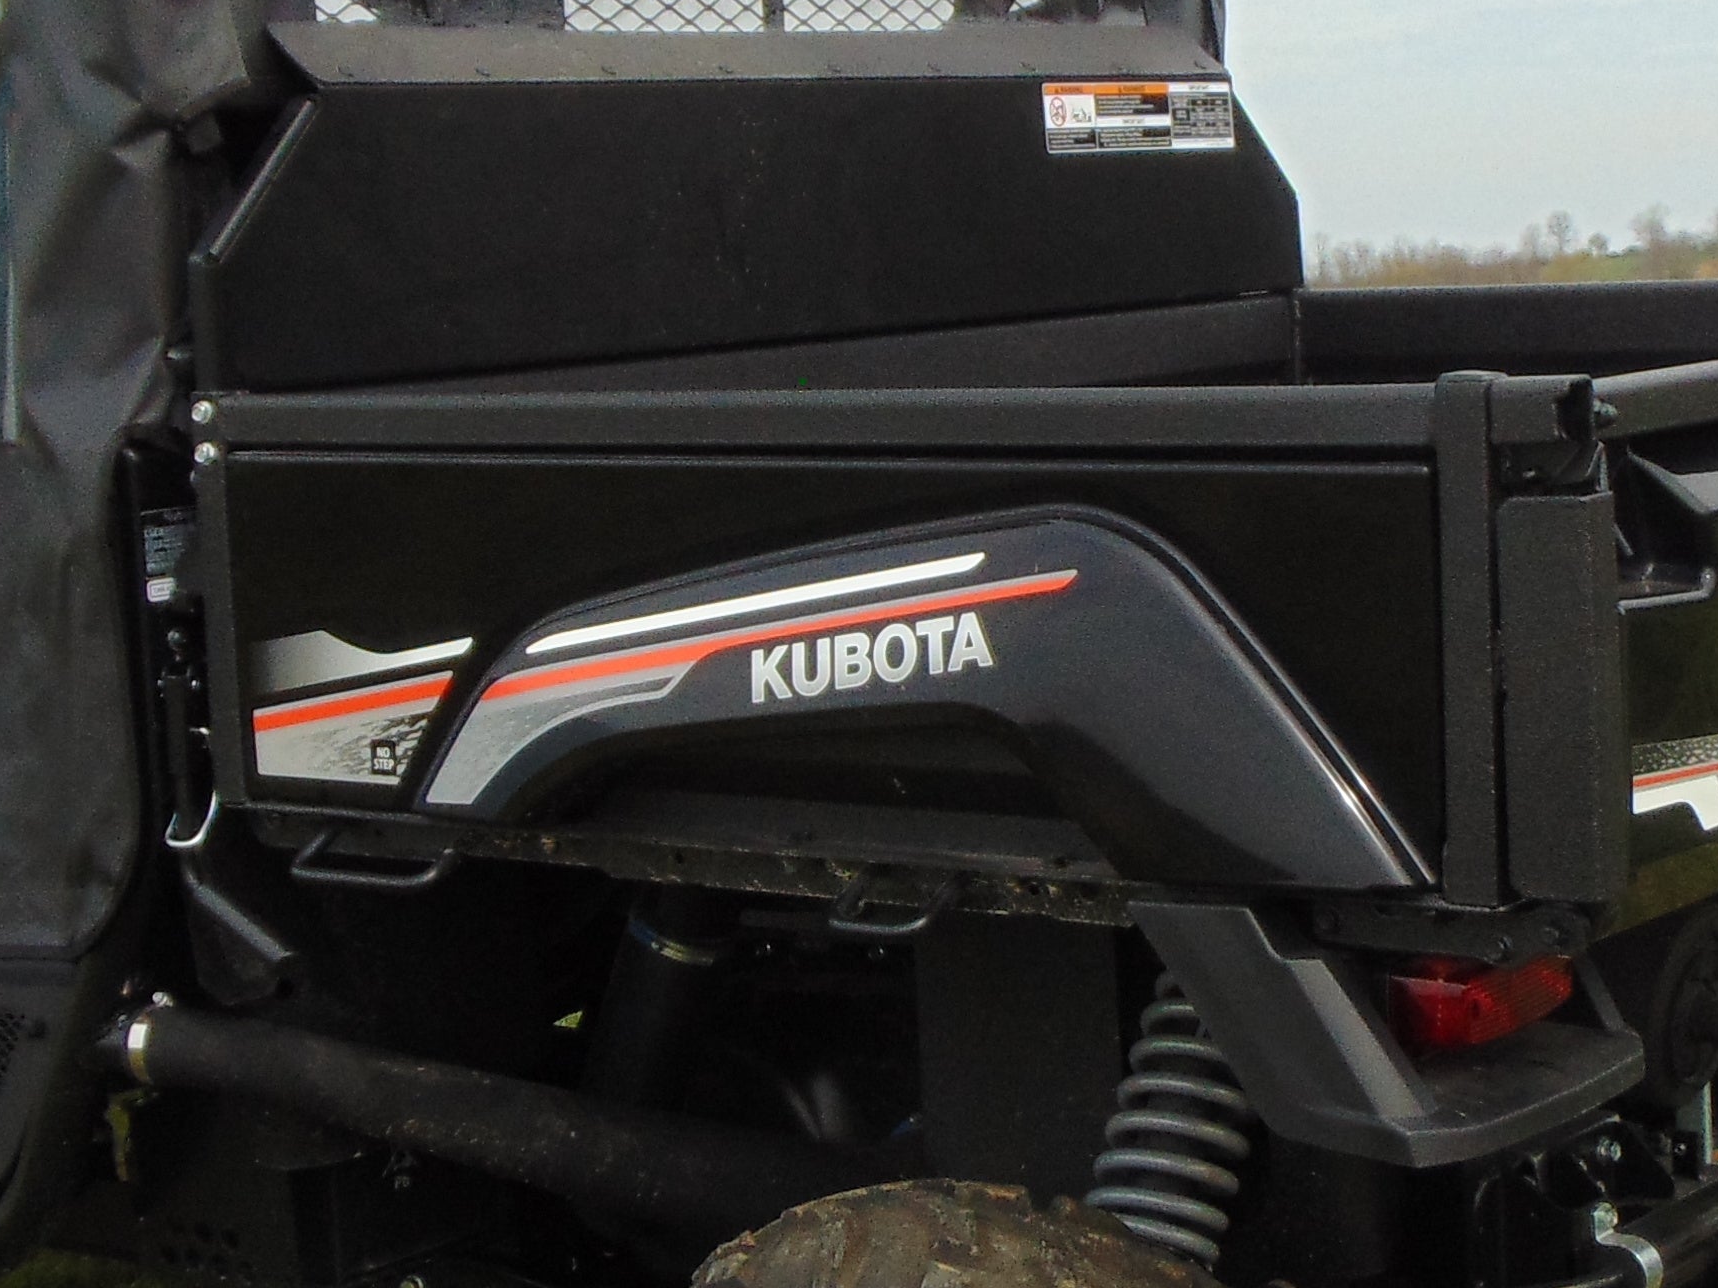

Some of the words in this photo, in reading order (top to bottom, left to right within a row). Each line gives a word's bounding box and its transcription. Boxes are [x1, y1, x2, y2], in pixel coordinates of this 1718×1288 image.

[751, 611, 994, 704] KUBOTA
[376, 746, 391, 758] NO
[373, 758, 395, 770] STEP
